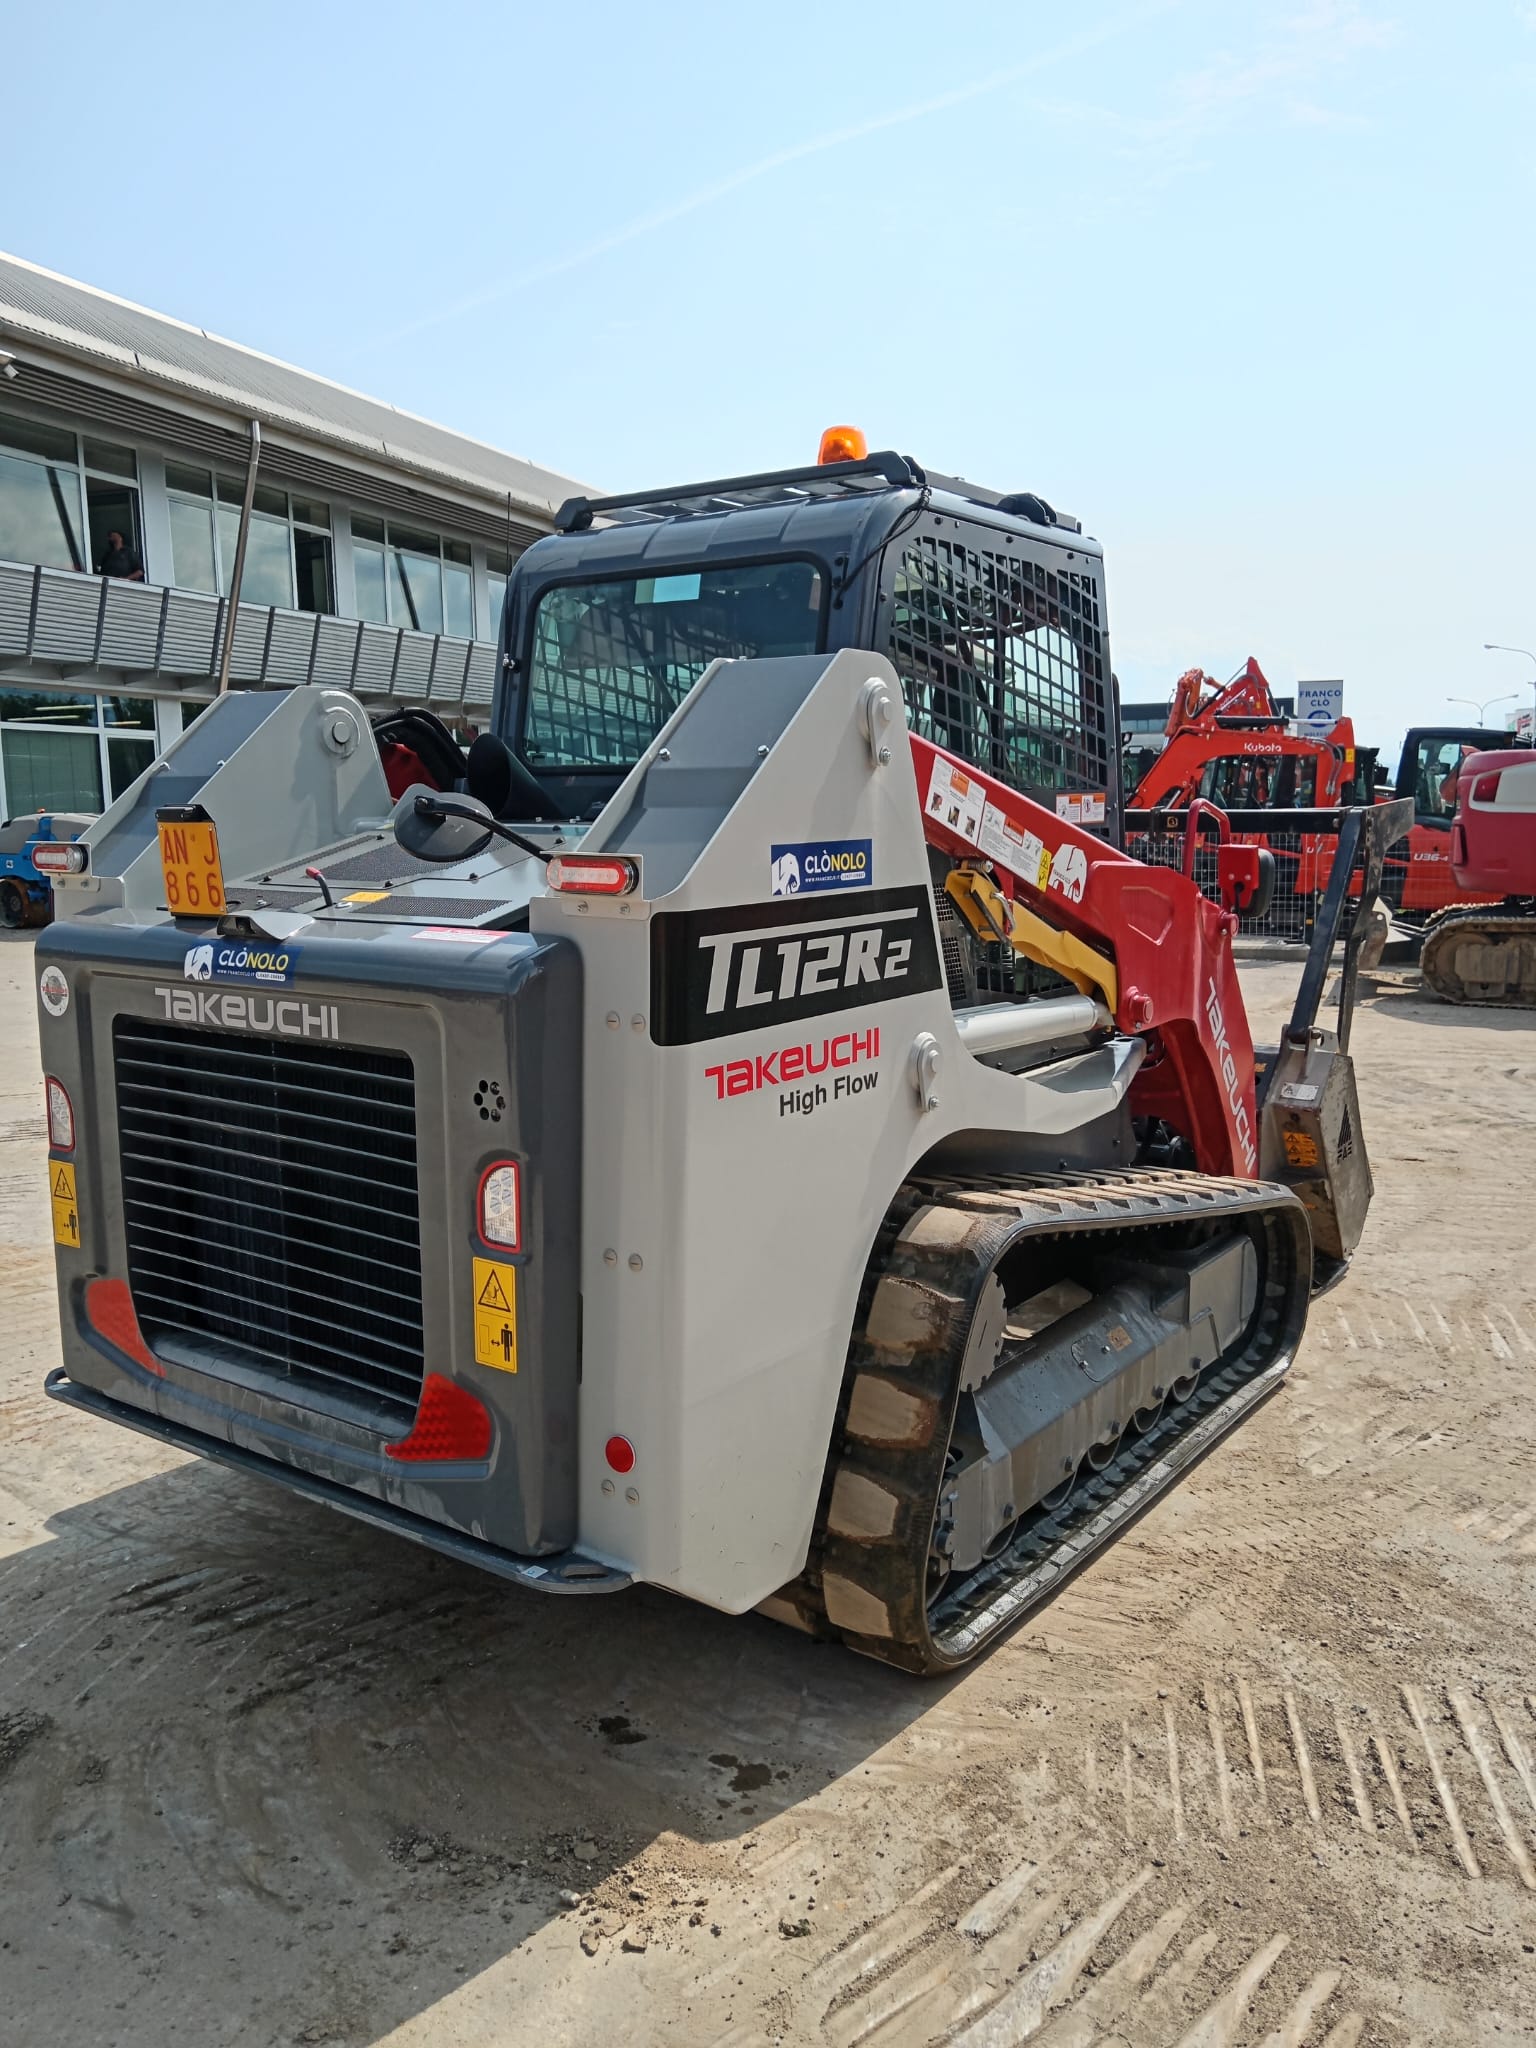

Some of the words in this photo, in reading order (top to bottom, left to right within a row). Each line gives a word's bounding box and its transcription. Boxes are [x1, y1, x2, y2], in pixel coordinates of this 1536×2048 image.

[1300, 689, 1342, 698] FRANCO
[1244, 743, 1282, 752] Kubota
[163, 829, 189, 865] AN
[204, 830, 216, 866] J
[1413, 853, 1449, 862] U36-4
[165, 871, 221, 908] 866
[698, 907, 919, 1015] TL12R2
[154, 987, 340, 1040] TAKEUCHI
[704, 1027, 880, 1100] TAKEUCHI
[1205, 976, 1257, 1174] TAKEUCHI
[779, 1084, 827, 1117] High
[833, 1071, 879, 1100] Flow
